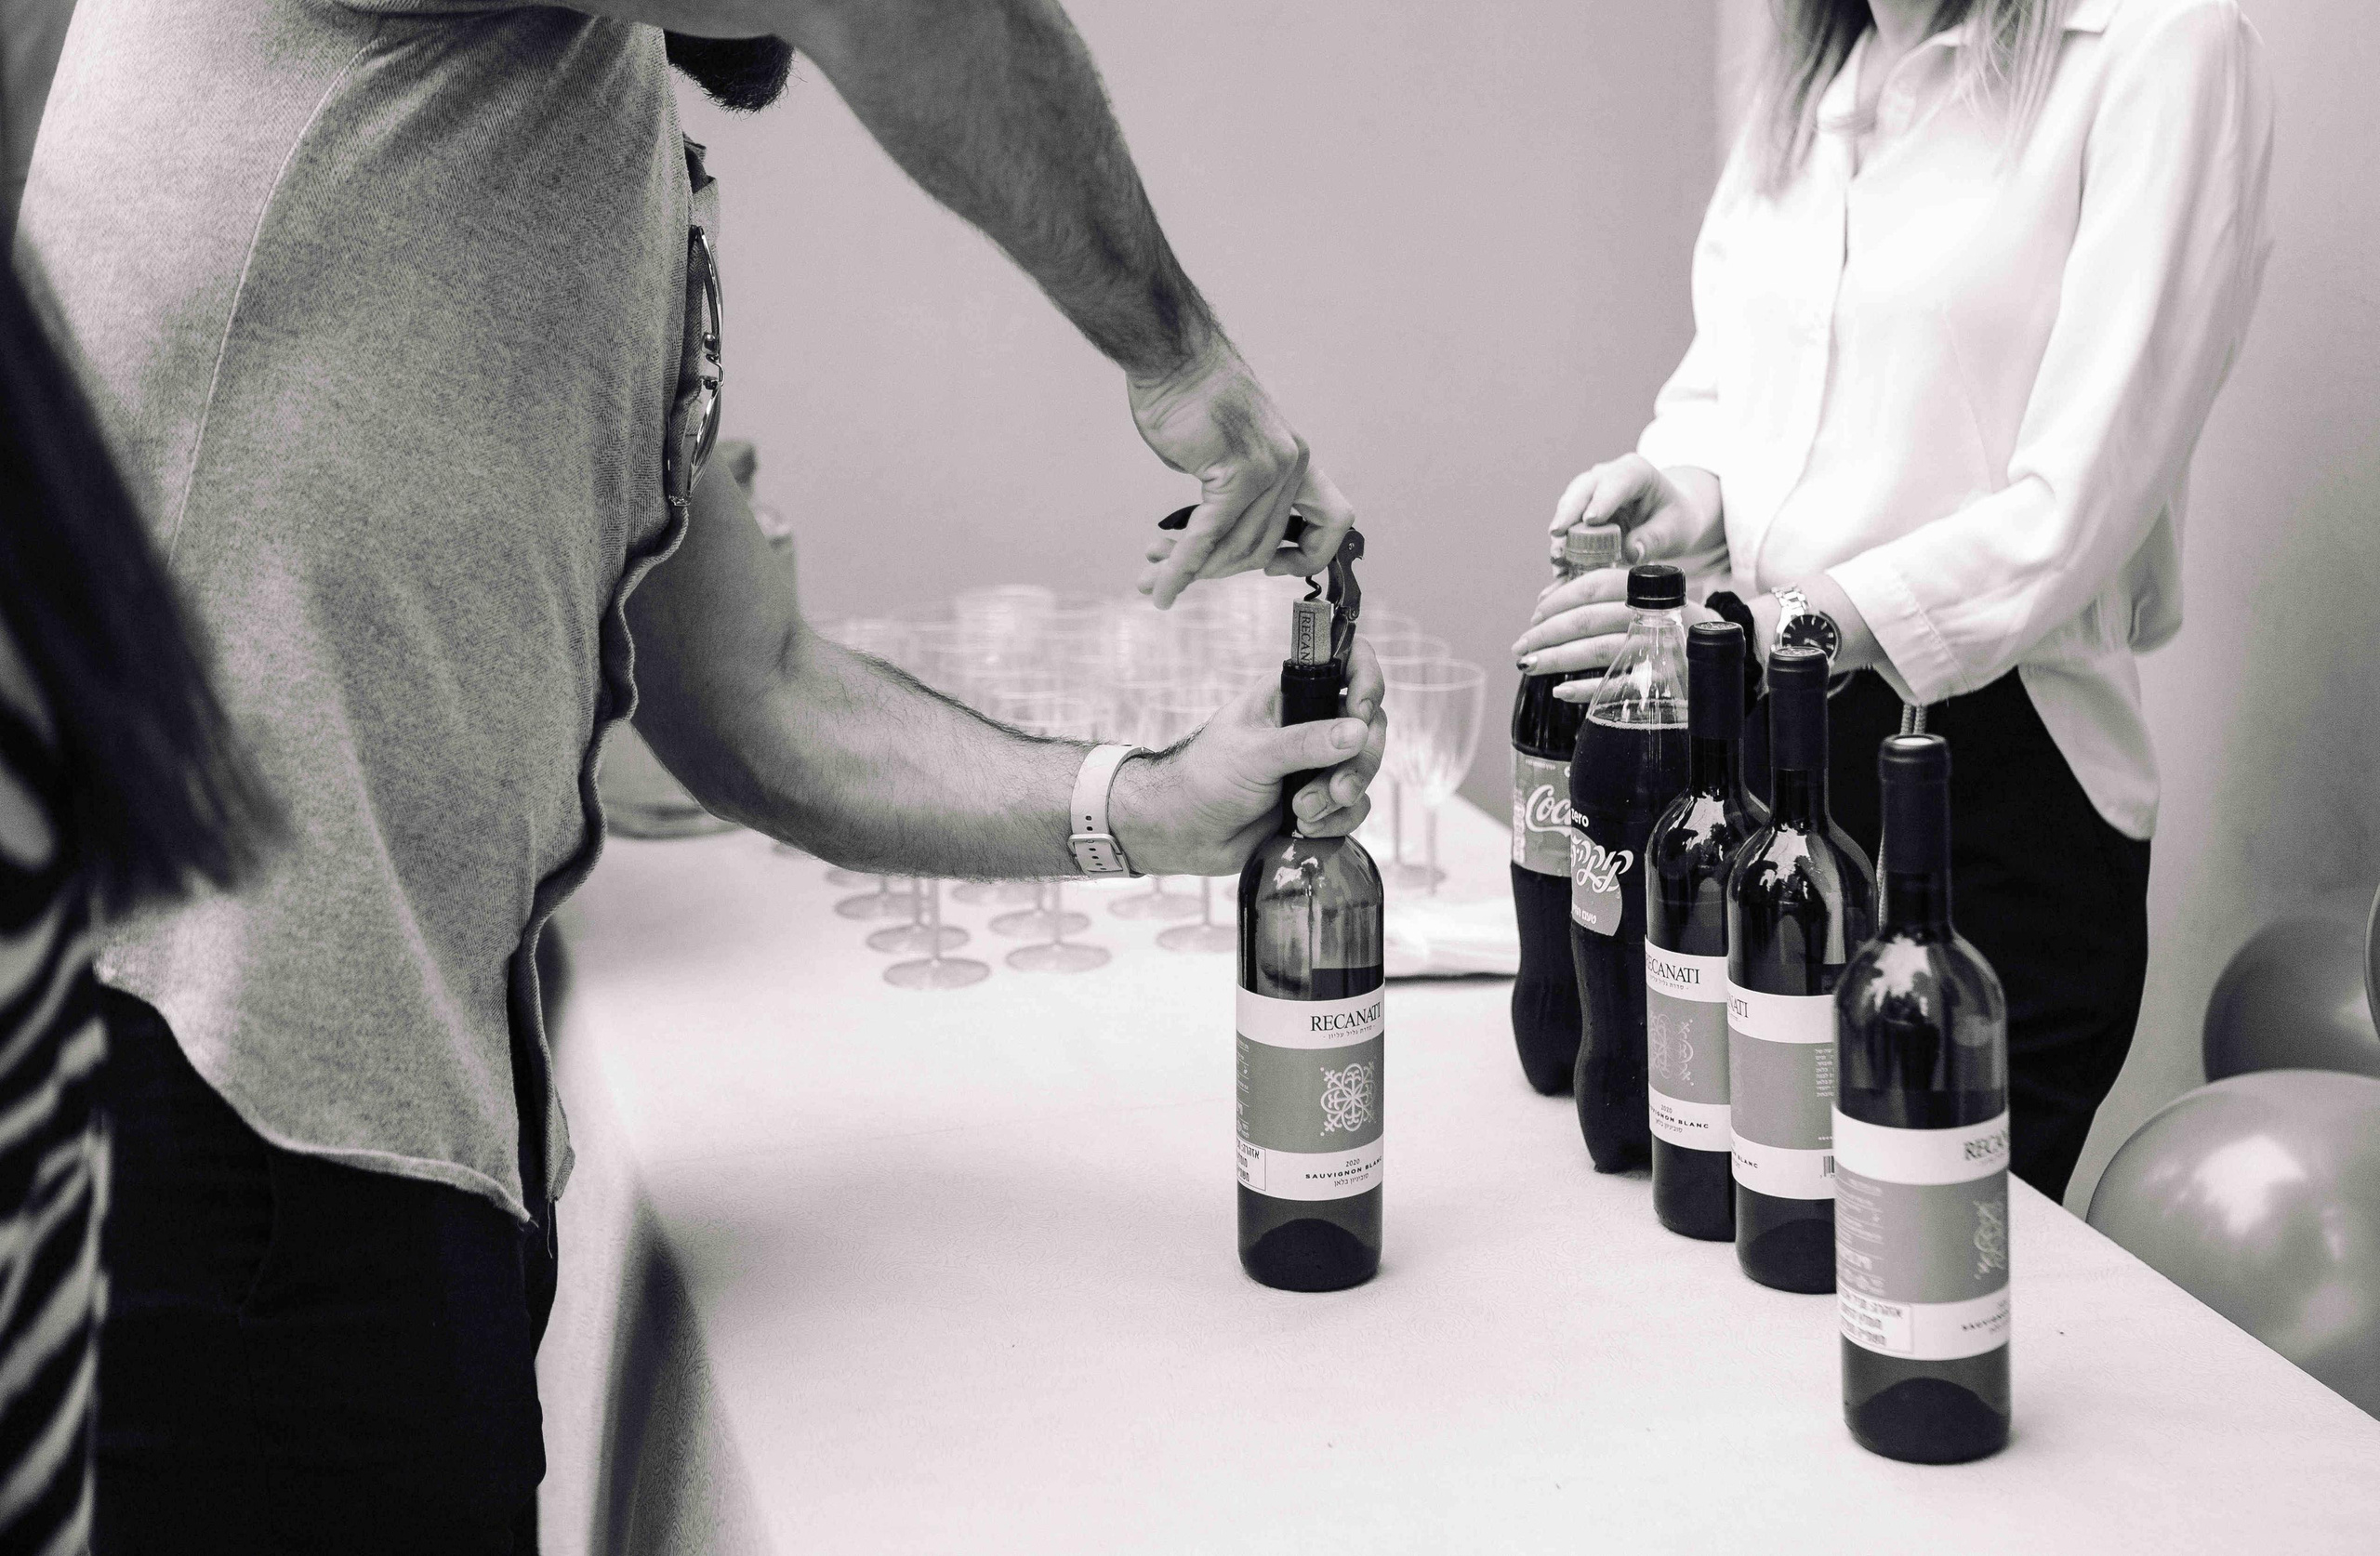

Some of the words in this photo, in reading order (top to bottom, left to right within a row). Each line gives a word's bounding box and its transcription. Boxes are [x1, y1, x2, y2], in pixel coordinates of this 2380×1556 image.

[1571, 808, 1590, 827] zero
[1310, 1002, 1381, 1032] RECANATI
[1678, 1119, 1709, 1128] BLANC
[1305, 1167, 1362, 1179] SAUVIGNON
[1365, 1155, 1382, 1170] BLANC
[1345, 1158, 1360, 1167] 2020
